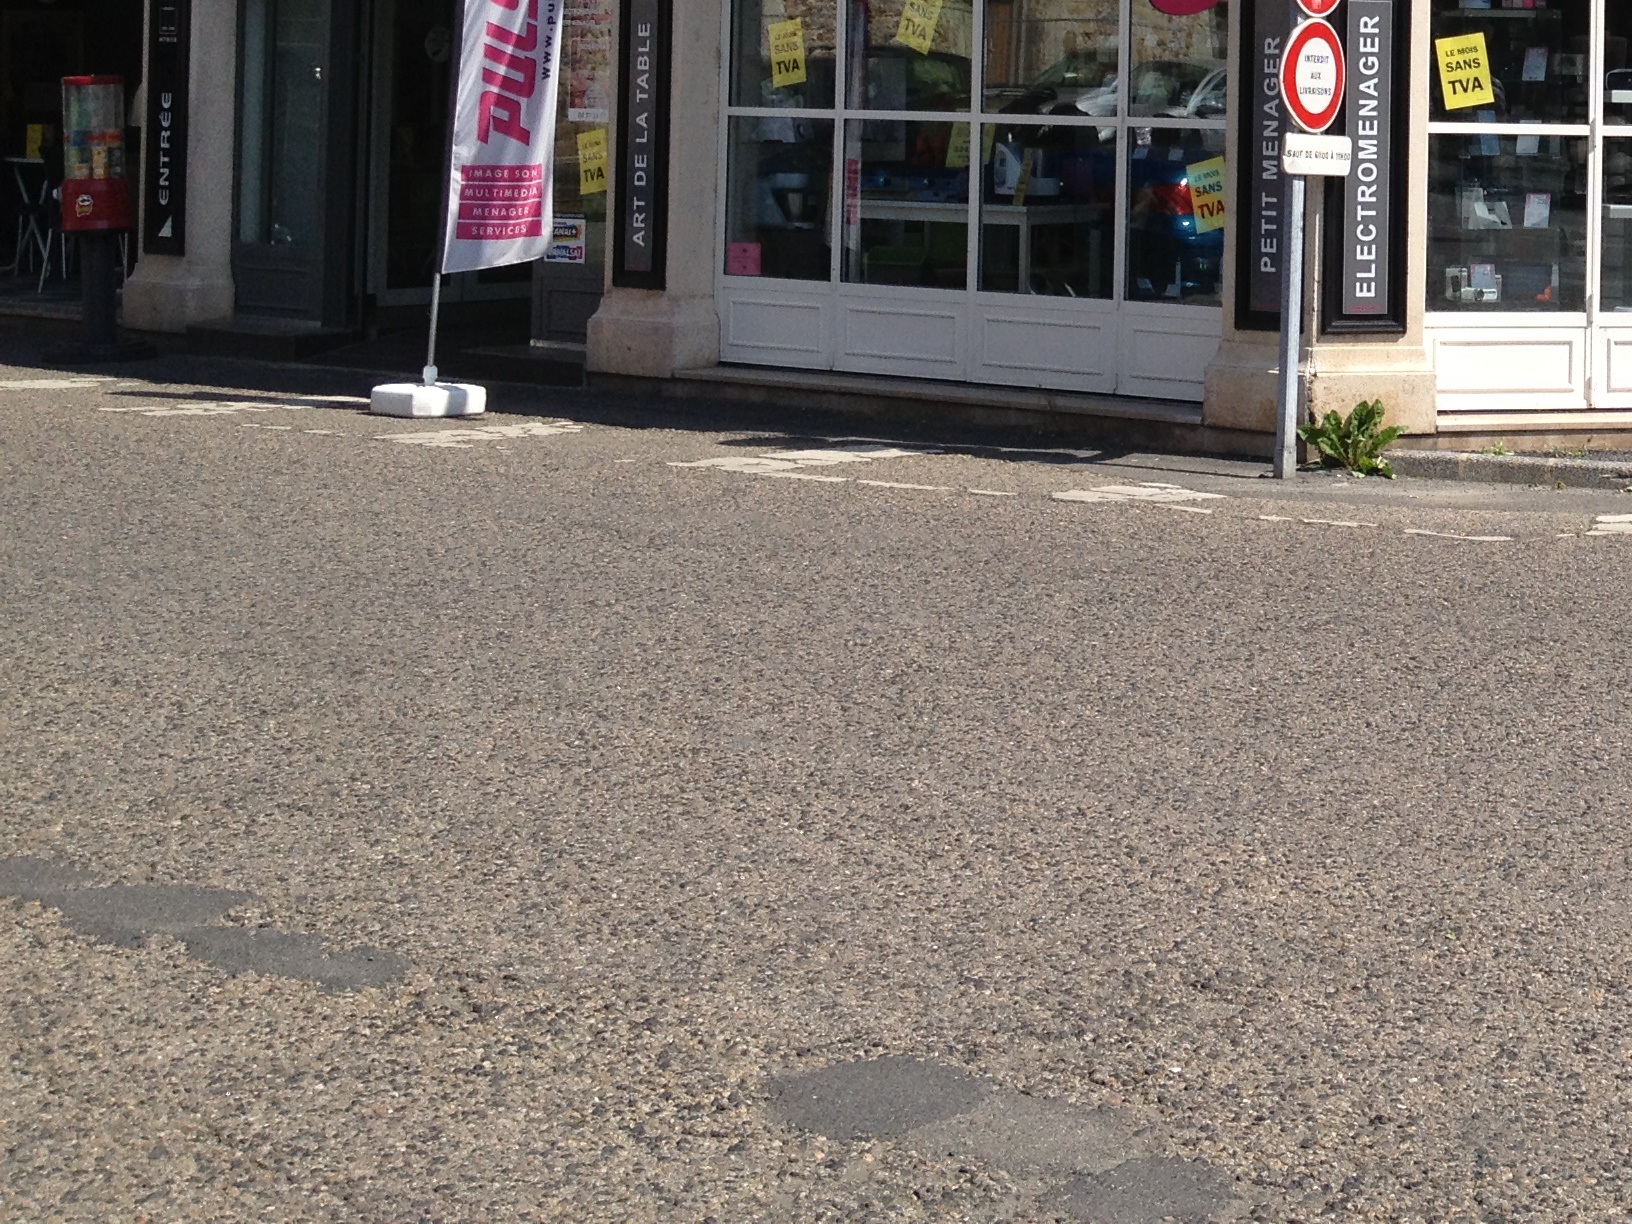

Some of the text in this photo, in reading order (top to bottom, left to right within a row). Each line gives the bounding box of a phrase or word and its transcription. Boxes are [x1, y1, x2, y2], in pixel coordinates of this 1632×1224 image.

[904, 18, 928, 41] TVA
[1445, 45, 1479, 57] LE MOIS
[776, 57, 800, 75] TVA
[1304, 55, 1330, 65] INTERDIT
[1445, 57, 1482, 73] SANS
[1310, 72, 1321, 81] AUX
[1299, 87, 1332, 97] LIVRAISONS
[1448, 76, 1485, 95] TVA
[632, 23, 651, 247] ART DE LA TABLE
[158, 92, 172, 206] ENTRÉE
[1260, 35, 1281, 273] PETIT MENAGER
[1305, 150, 1313, 159] DE
[1355, 15, 1380, 298] ELECTROMENAGER
[468, 168, 538, 179] IMAGE SON
[583, 166, 605, 183] TVA
[464, 186, 538, 197] MULTIMEDIA
[1195, 180, 1223, 197] SANS
[473, 207, 530, 216] MENAGER
[1197, 199, 1225, 219] TVA
[472, 224, 527, 236] SERVICES
